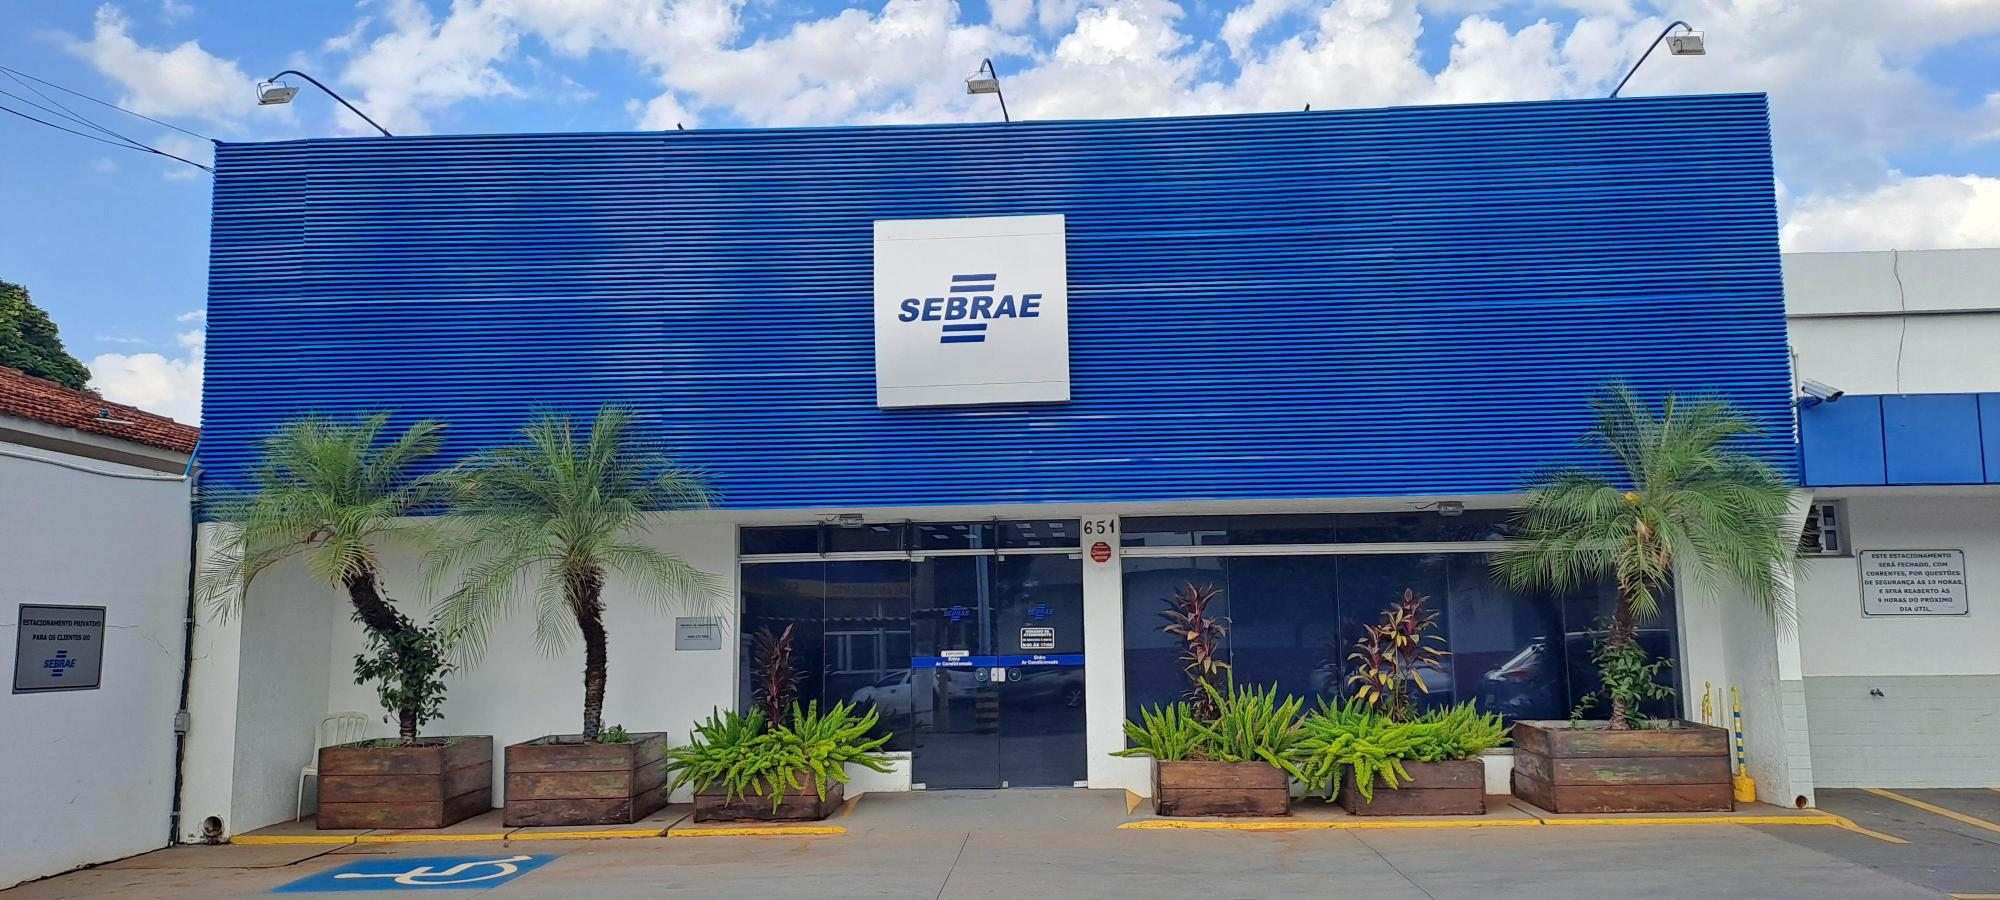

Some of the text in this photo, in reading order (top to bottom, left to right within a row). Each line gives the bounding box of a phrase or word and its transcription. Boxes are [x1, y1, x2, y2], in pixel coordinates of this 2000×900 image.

[898, 293, 1042, 323] SEBRAE
[1084, 519, 1115, 535] 651
[1875, 579, 1916, 587] SEGURANÇA
[22, 619, 73, 627] ESTACIONAMENTO
[43, 659, 77, 669] SEBRAE
